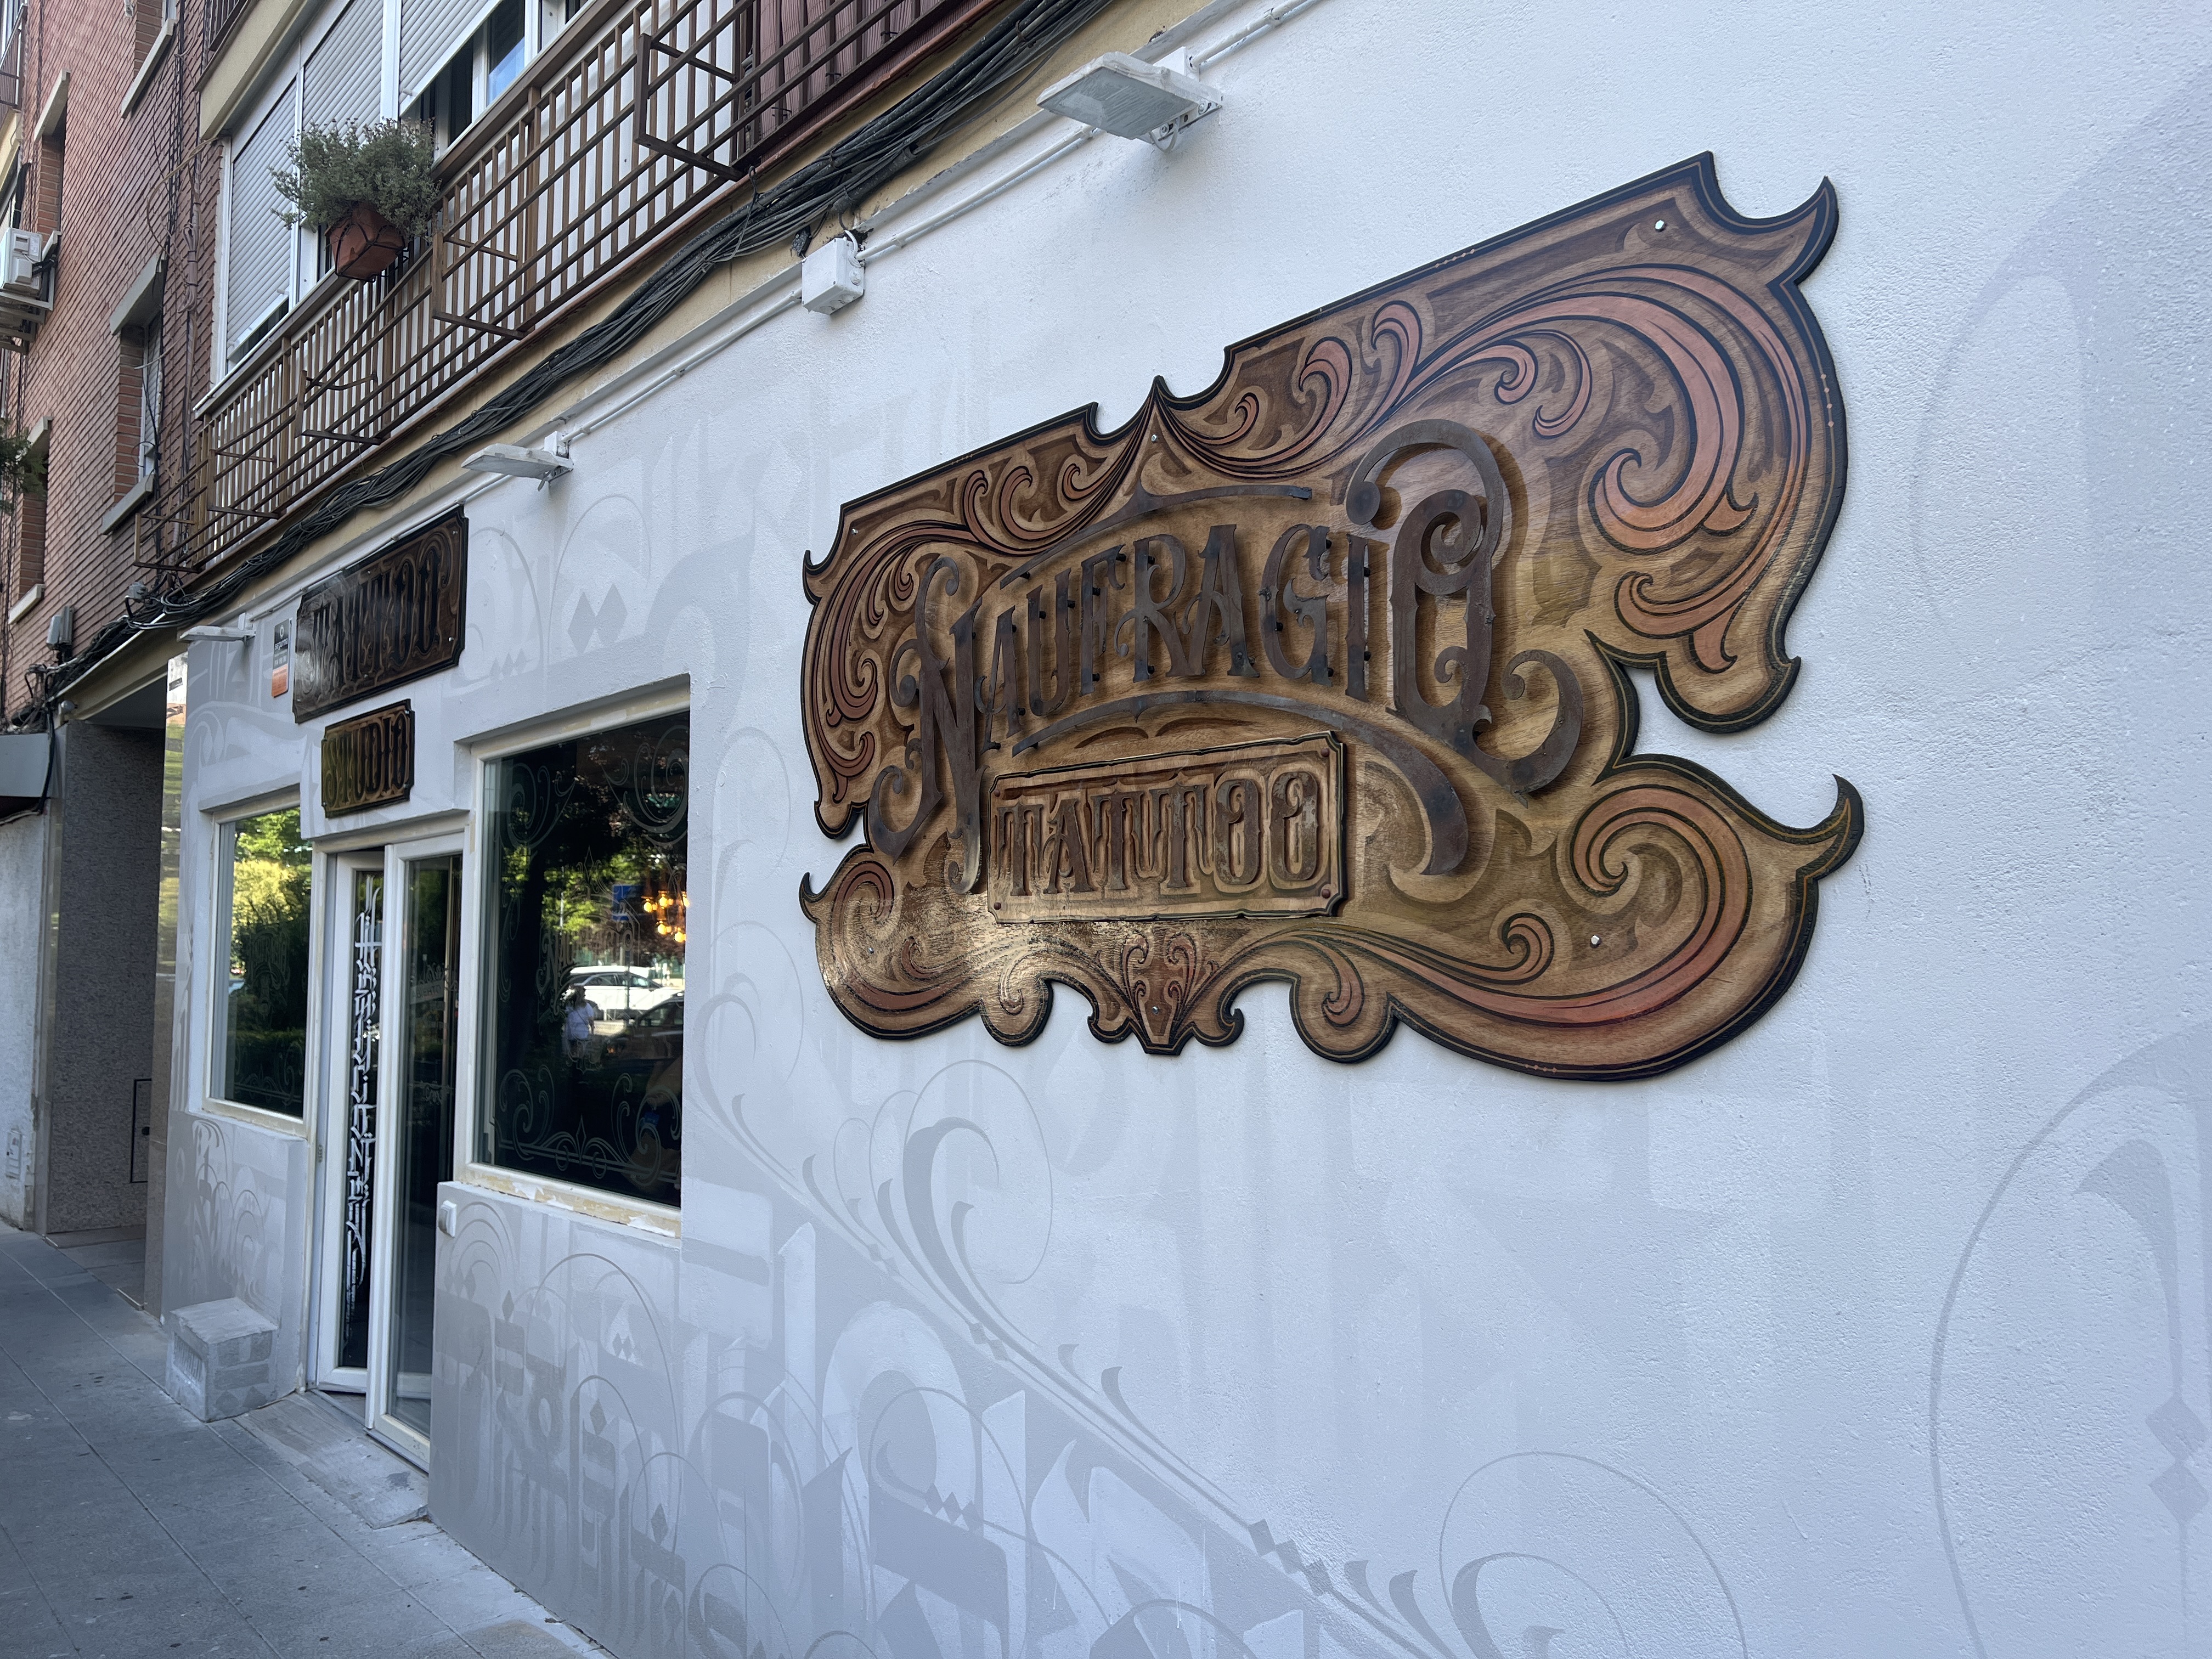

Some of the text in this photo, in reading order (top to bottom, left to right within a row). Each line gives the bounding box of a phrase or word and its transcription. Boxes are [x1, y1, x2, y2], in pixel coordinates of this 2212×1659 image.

[877, 419, 1583, 894] NAUFRAGIO
[325, 713, 407, 808] STUDIO
[995, 769, 1319, 897] TATTOO
